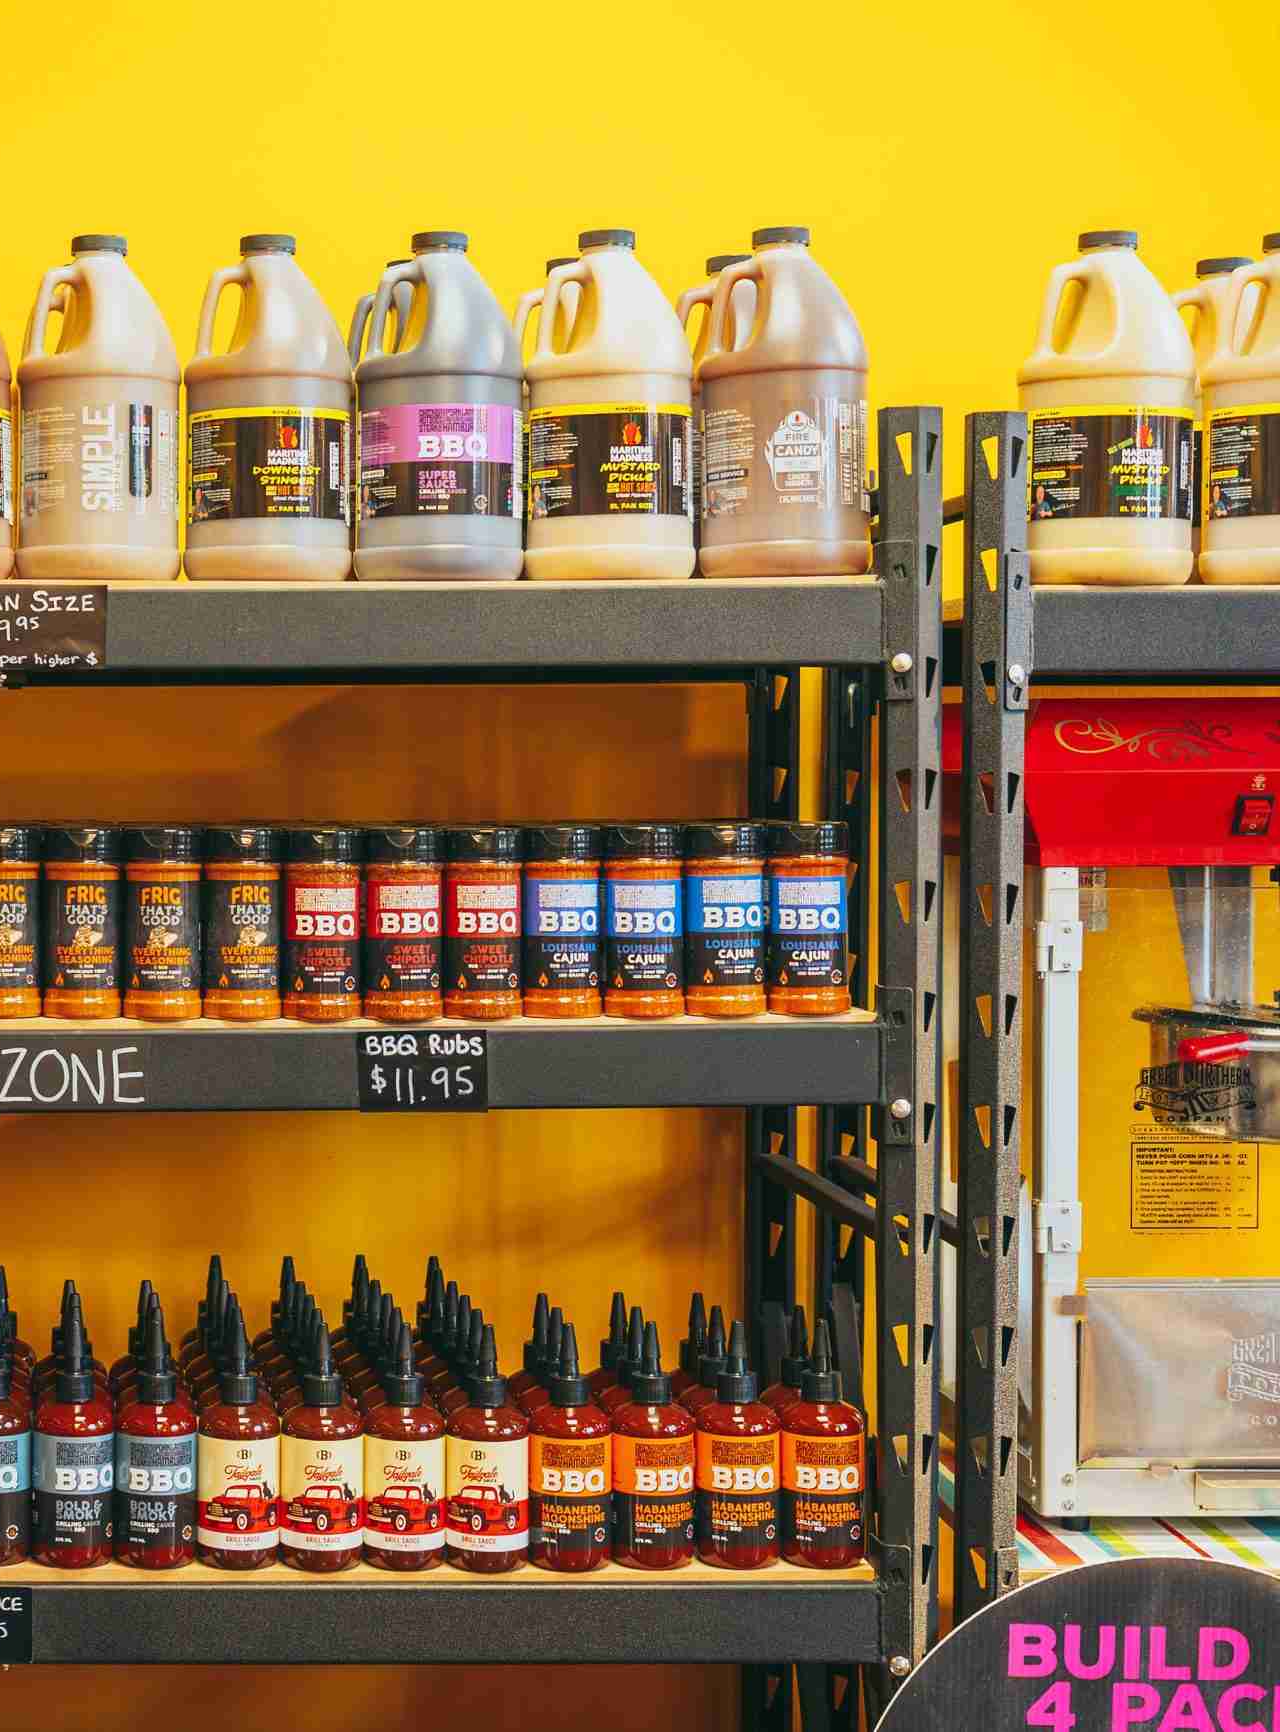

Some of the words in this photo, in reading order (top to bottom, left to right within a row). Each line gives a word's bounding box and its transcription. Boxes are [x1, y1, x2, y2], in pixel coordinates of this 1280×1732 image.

[417, 436, 488, 457] BBQ
[419, 471, 456, 479] SUPER
[600, 463, 660, 472] MUSTARD
[419, 480, 456, 488] SAUCE
[30, 591, 94, 612] SIZE
[34, 653, 80, 668] higher
[86, 652, 97, 666] $
[67, 886, 105, 904] FRIG
[141, 887, 180, 904] FRIG
[232, 887, 269, 904] FRIG
[65, 905, 108, 914] THAT'S
[140, 906, 183, 916] THAT'S
[229, 905, 272, 915] THAT'S
[703, 906, 761, 927] BBQ
[67, 915, 105, 925] GOOD
[143, 915, 180, 926] GOOD
[232, 915, 269, 925] GOOD
[295, 914, 354, 936] BBQ
[380, 912, 438, 934] BBQ
[458, 912, 516, 934] BBQ
[539, 910, 597, 932] BBQ
[615, 911, 675, 933] BBQ
[779, 907, 840, 929] BBQ
[553, 953, 589, 962] CAJUN
[628, 954, 664, 964] CAJUN
[718, 949, 753, 958] CAJUN
[792, 951, 829, 960] CAJUN
[365, 1034, 418, 1056] BBQ
[429, 1033, 483, 1056] Rubs
[371, 1064, 474, 1104] $11.95
[56, 1466, 112, 1490] BBQ
[129, 1467, 192, 1491] BBQ
[542, 1468, 604, 1492] BBQ
[635, 1468, 693, 1491] BBQ
[712, 1467, 774, 1490] BBQ
[796, 1467, 859, 1490] BBQ
[56, 1500, 90, 1511] BOLD
[129, 1500, 164, 1511] BOLD
[542, 1503, 600, 1514] HABANERO
[636, 1503, 690, 1513] HABANERO
[712, 1501, 770, 1512] HABANERO
[796, 1501, 855, 1512] HABANERO
[56, 1511, 100, 1520] SMOKY
[129, 1510, 175, 1520] SMOKY
[1008, 1623, 1250, 1680] BUILD
[1027, 1682, 1076, 1732] 4
[1112, 1683, 1280, 1732] PAC
